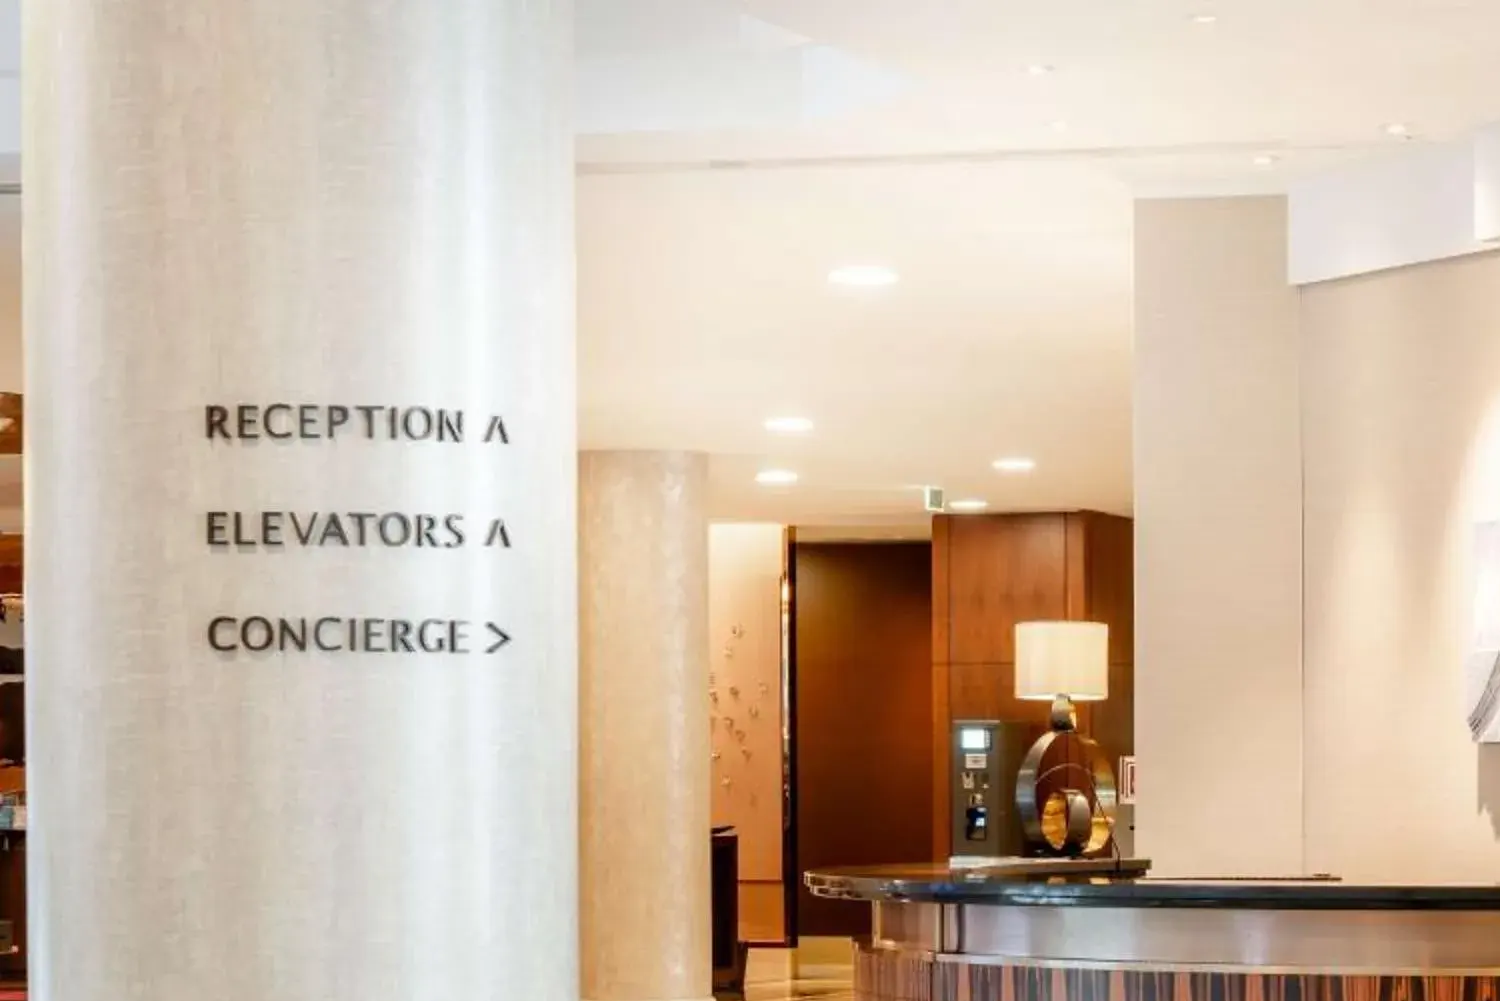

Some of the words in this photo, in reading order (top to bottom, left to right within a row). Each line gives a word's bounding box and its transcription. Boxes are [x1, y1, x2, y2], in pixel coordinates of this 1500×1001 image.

[205, 403, 463, 443] RECEPTION
[206, 511, 464, 548] ELEVATORS
[207, 616, 469, 653] CONCIERGE
